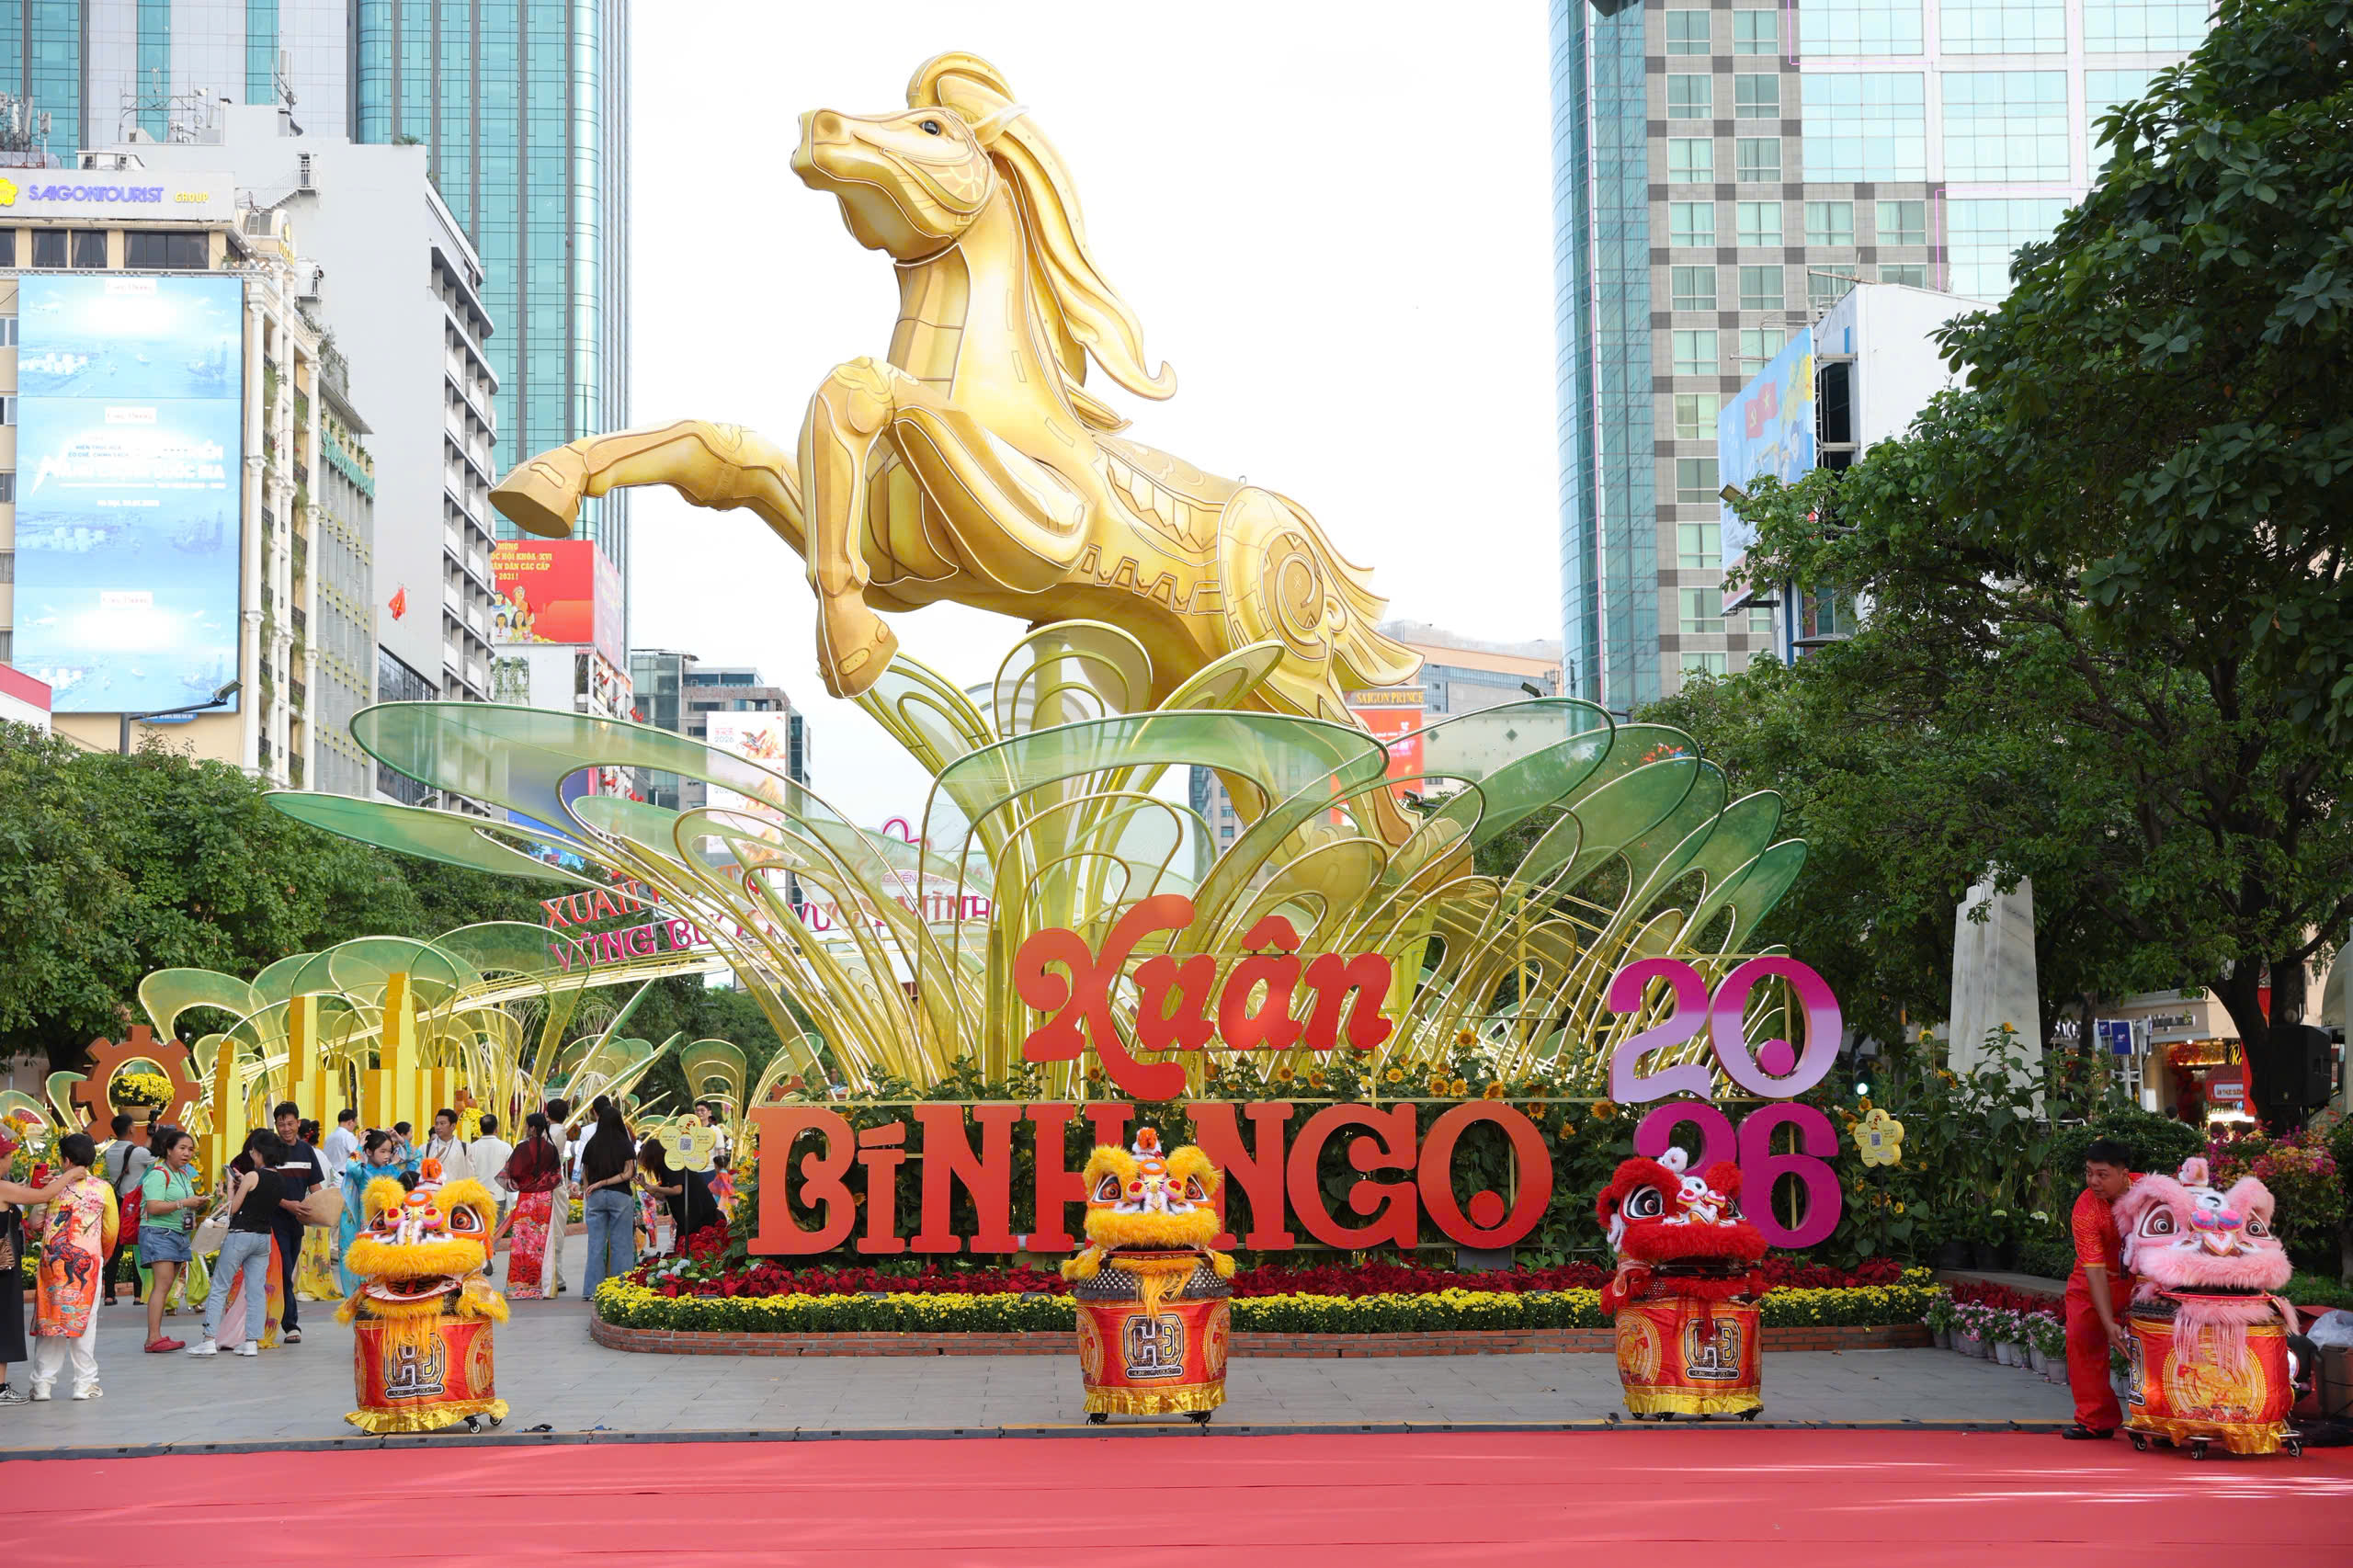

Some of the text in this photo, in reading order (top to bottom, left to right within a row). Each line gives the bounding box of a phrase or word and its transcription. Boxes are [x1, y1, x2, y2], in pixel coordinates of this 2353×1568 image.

[28, 184, 209, 203] SAIGONTOURIST GROUP
[1356, 691, 1425, 704] SAIGON PRINCE
[1015, 894, 1393, 1100] Xuân
[1608, 956, 1843, 1103] 20
[747, 1102, 1136, 1256] BÍNH
